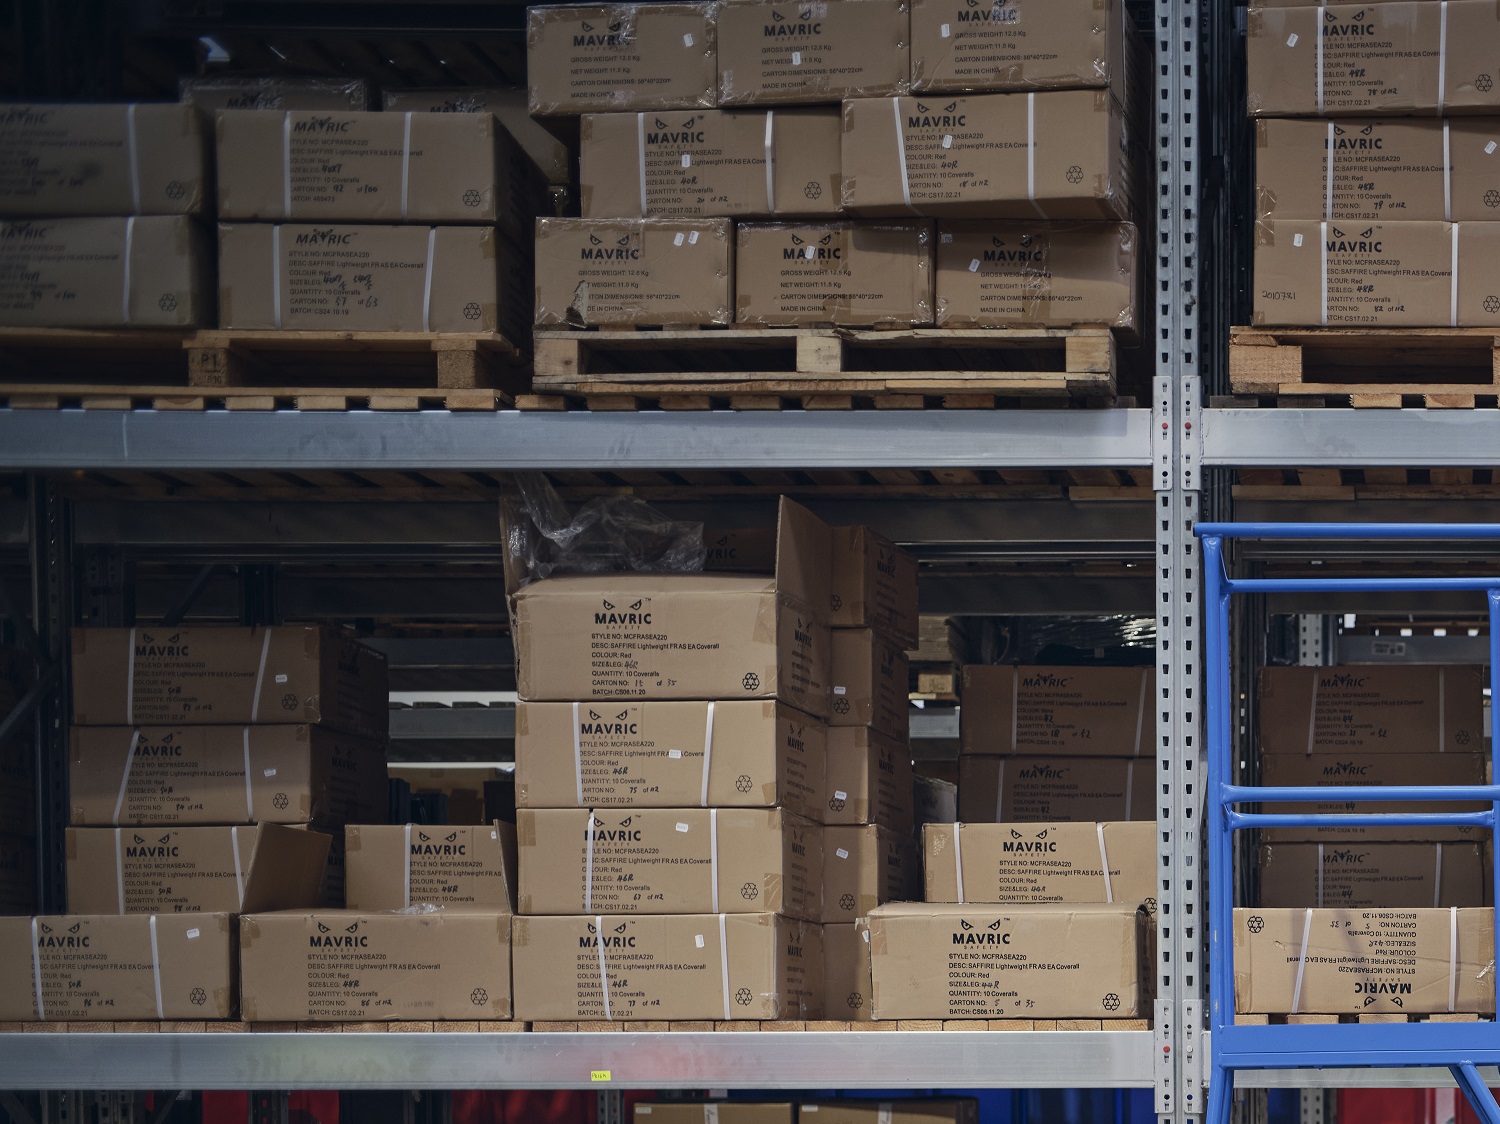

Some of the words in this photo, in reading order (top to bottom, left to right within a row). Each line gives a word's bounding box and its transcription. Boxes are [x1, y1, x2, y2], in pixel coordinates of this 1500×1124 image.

[764, 24, 821, 36] MAVRIC
[909, 116, 966, 127] MAVRIC
[647, 132, 704, 144] MAVRIC
[581, 248, 640, 259] MAVRIC
[983, 250, 1041, 261] MAVRIC
[844, 268, 851, 277] Kg
[595, 614, 651, 624] MAVRIC
[135, 646, 188, 656] MAVRIC
[581, 724, 637, 734] MAVRIC
[126, 847, 179, 857] MAVRIC
[411, 845, 465, 855] MAVRIC
[1003, 842, 1056, 852] MAVRIC
[310, 936, 368, 947] MAVRIC
[953, 934, 1010, 944] MAVRIC
[1355, 983, 1411, 994] MAVRIC
